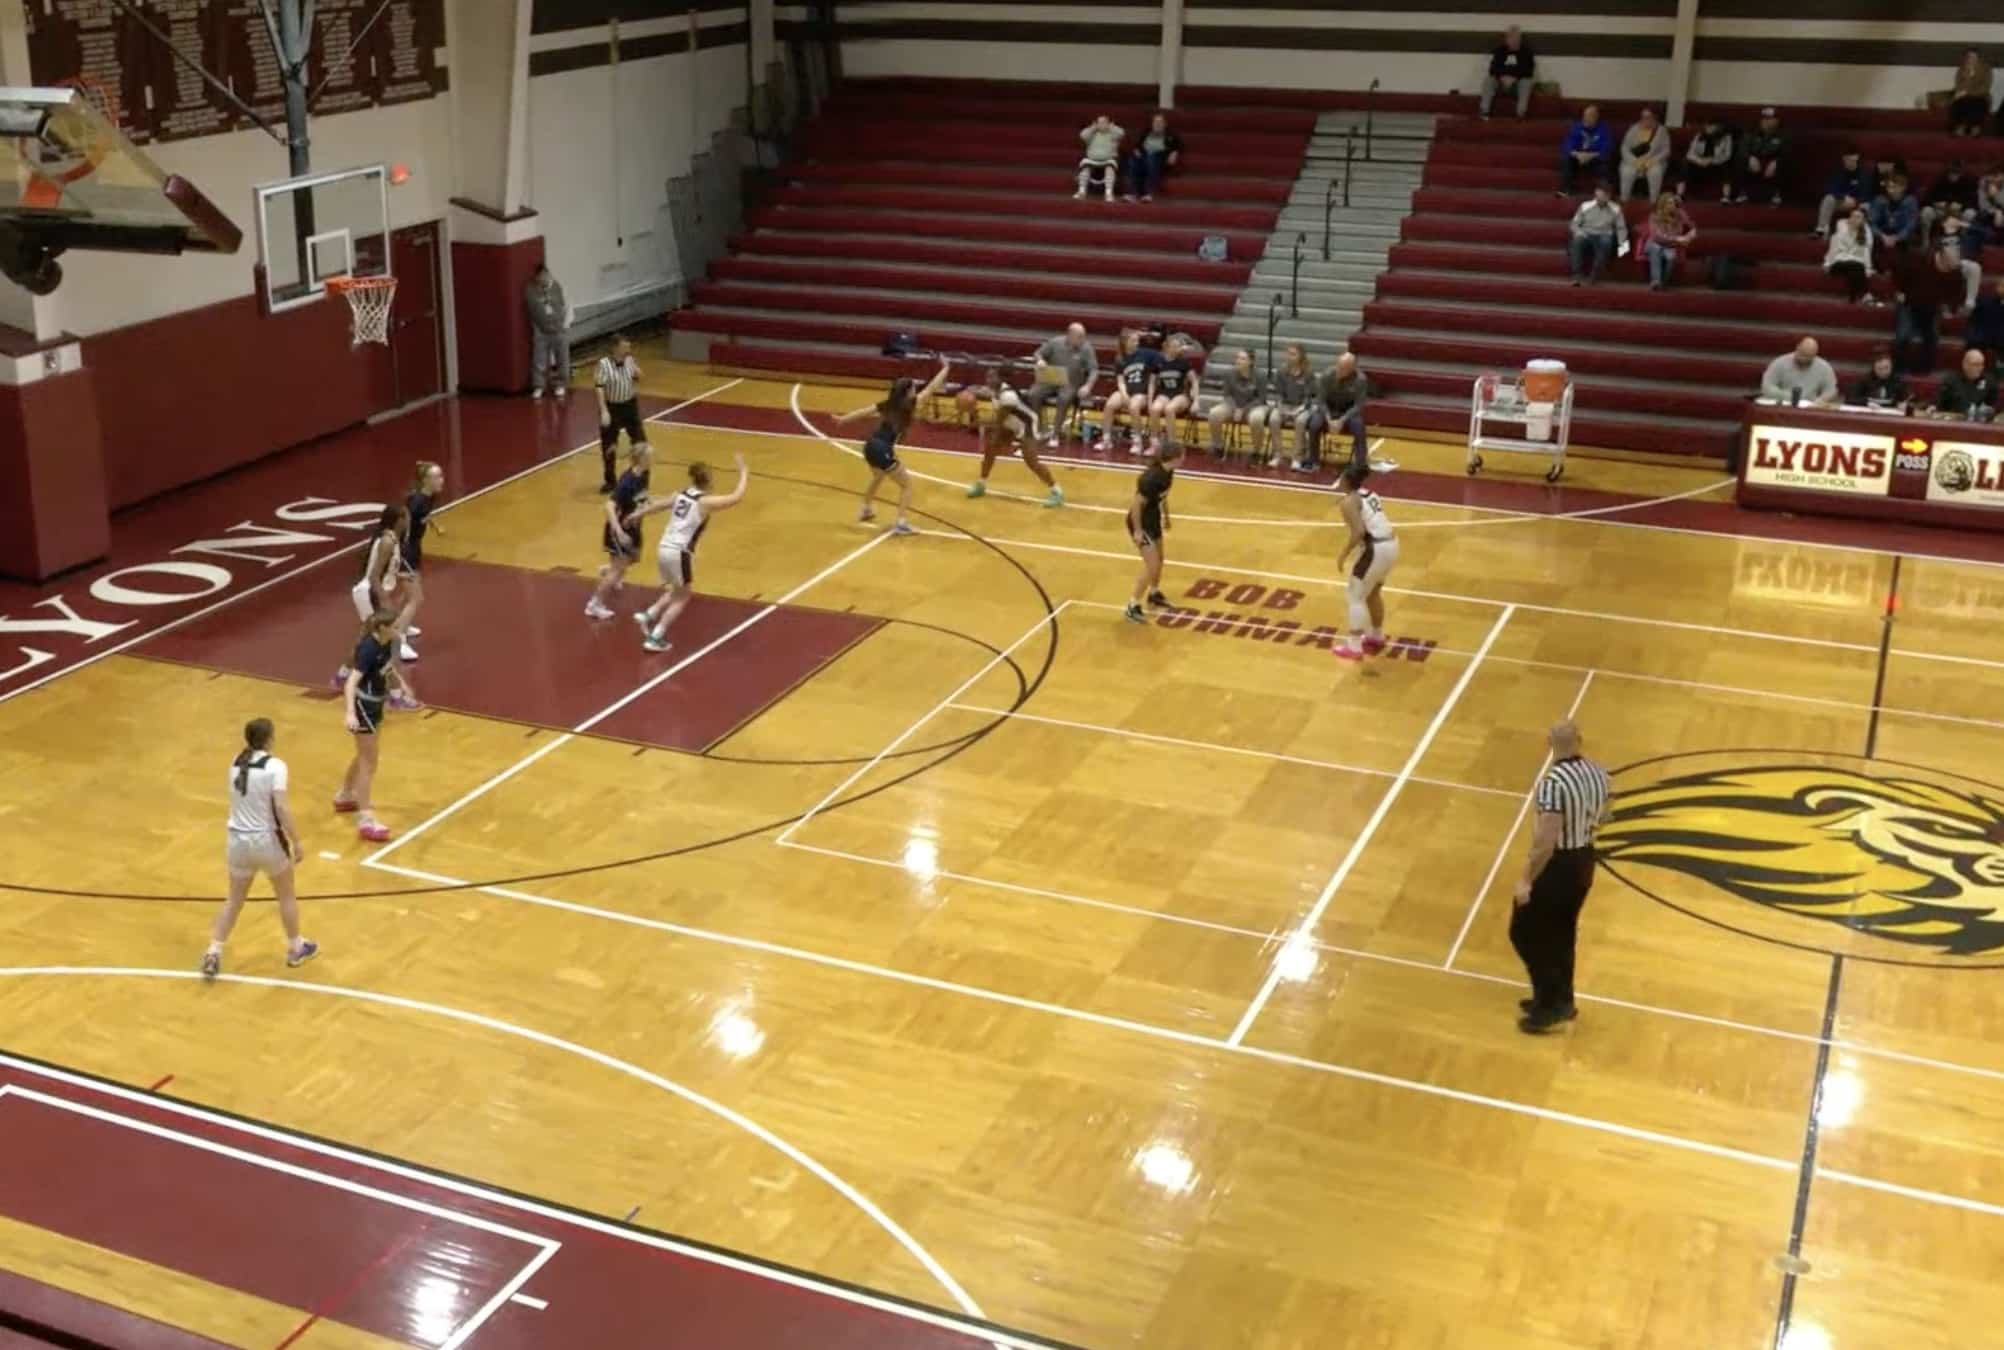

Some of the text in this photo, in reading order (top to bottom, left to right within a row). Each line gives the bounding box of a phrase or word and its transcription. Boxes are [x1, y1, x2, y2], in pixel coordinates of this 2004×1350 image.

[1754, 438, 1887, 478] LYONS
[1895, 454, 1928, 470] POSS
[1775, 473, 1857, 489] HIGH SCHOOL
[1974, 458, 2004, 492] L
[1183, 578, 1306, 611] BOB
